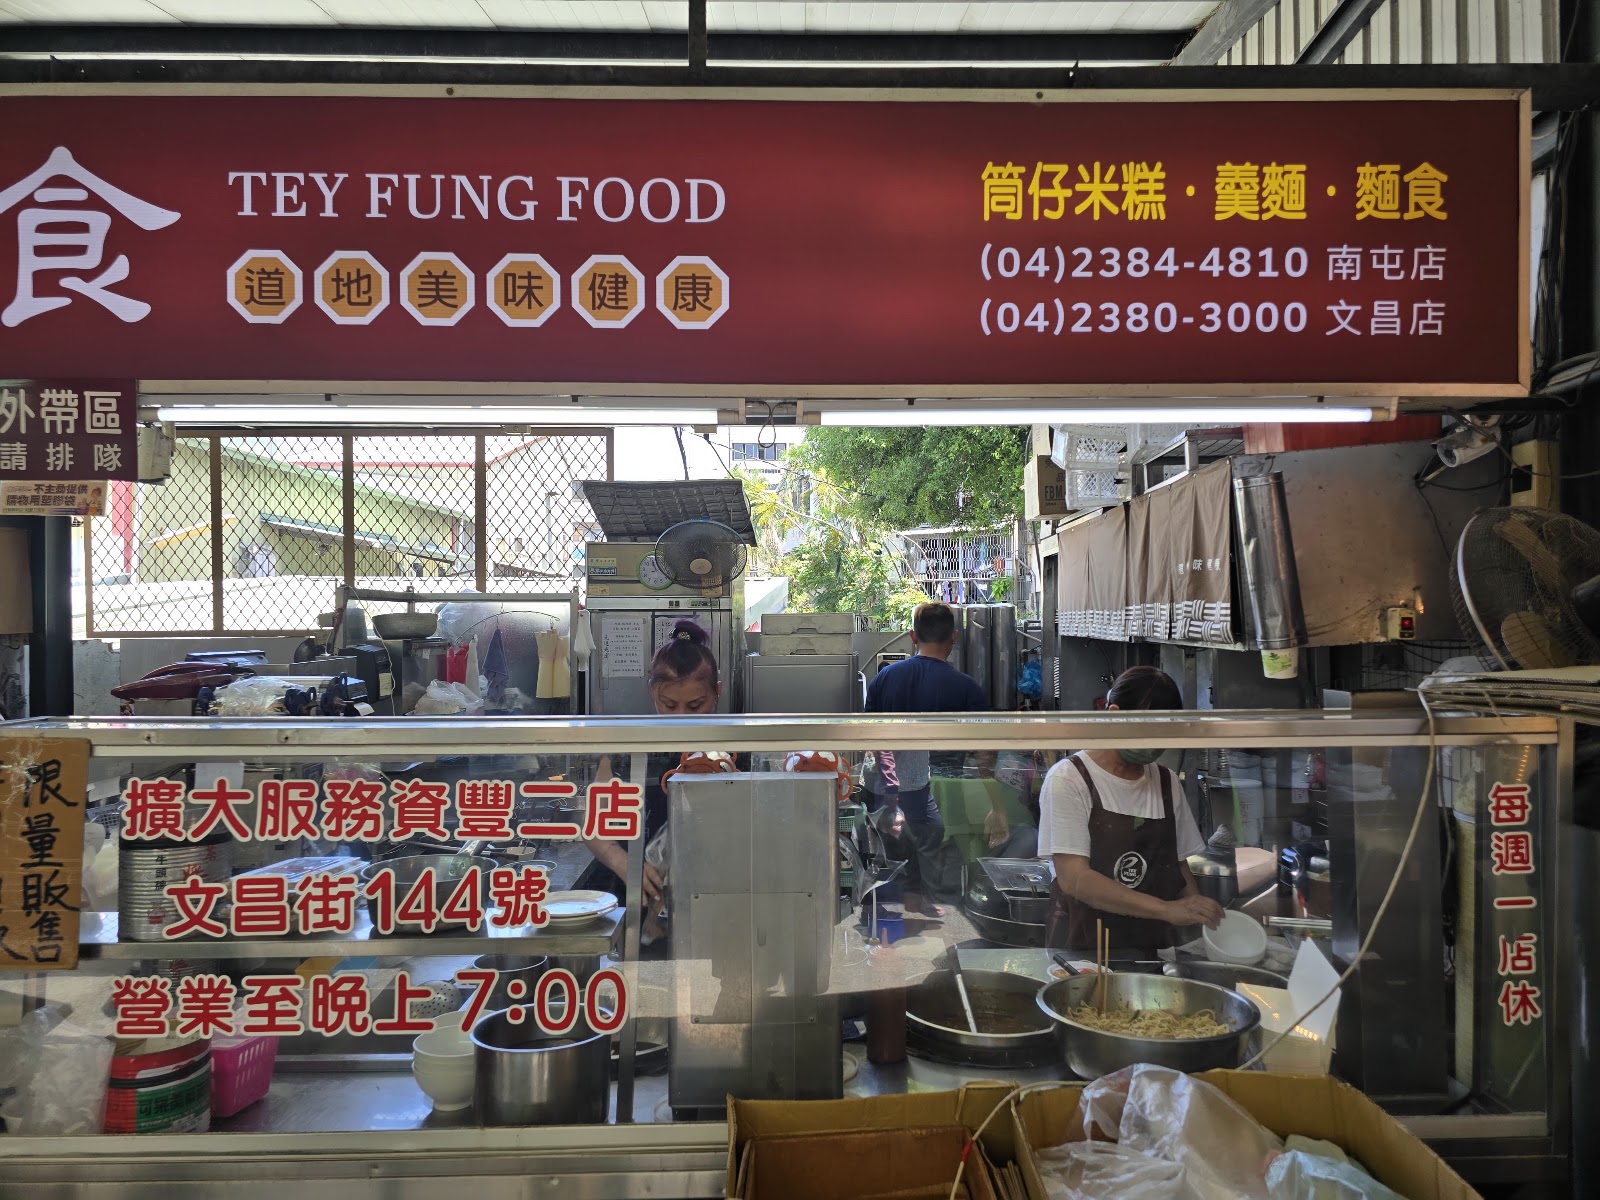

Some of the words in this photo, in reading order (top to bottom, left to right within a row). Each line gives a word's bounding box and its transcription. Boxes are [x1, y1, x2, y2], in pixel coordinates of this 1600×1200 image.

[229, 172, 348, 217] TEY
[366, 174, 538, 220] FUNG
[557, 177, 726, 223] FOOD
[0, 147, 181, 327] 食
[981, 243, 1308, 283] (04)2384-4810
[1327, 245, 1446, 281] 南屯店
[980, 298, 1307, 336] (04)2380-3000
[1326, 300, 1446, 336] 文昌店
[0, 389, 122, 435] 外帶區
[0, 442, 122, 472] 請排隊
[7, 495, 76, 506] 購物用塑膠袋
[34, 484, 88, 494] 不主動提供
[122, 778, 641, 840] 擴大服務資豐二店
[21, 758, 80, 963] 限量販售
[166, 867, 548, 937] 文昌街144號
[1490, 784, 1539, 1024] 每週一店休
